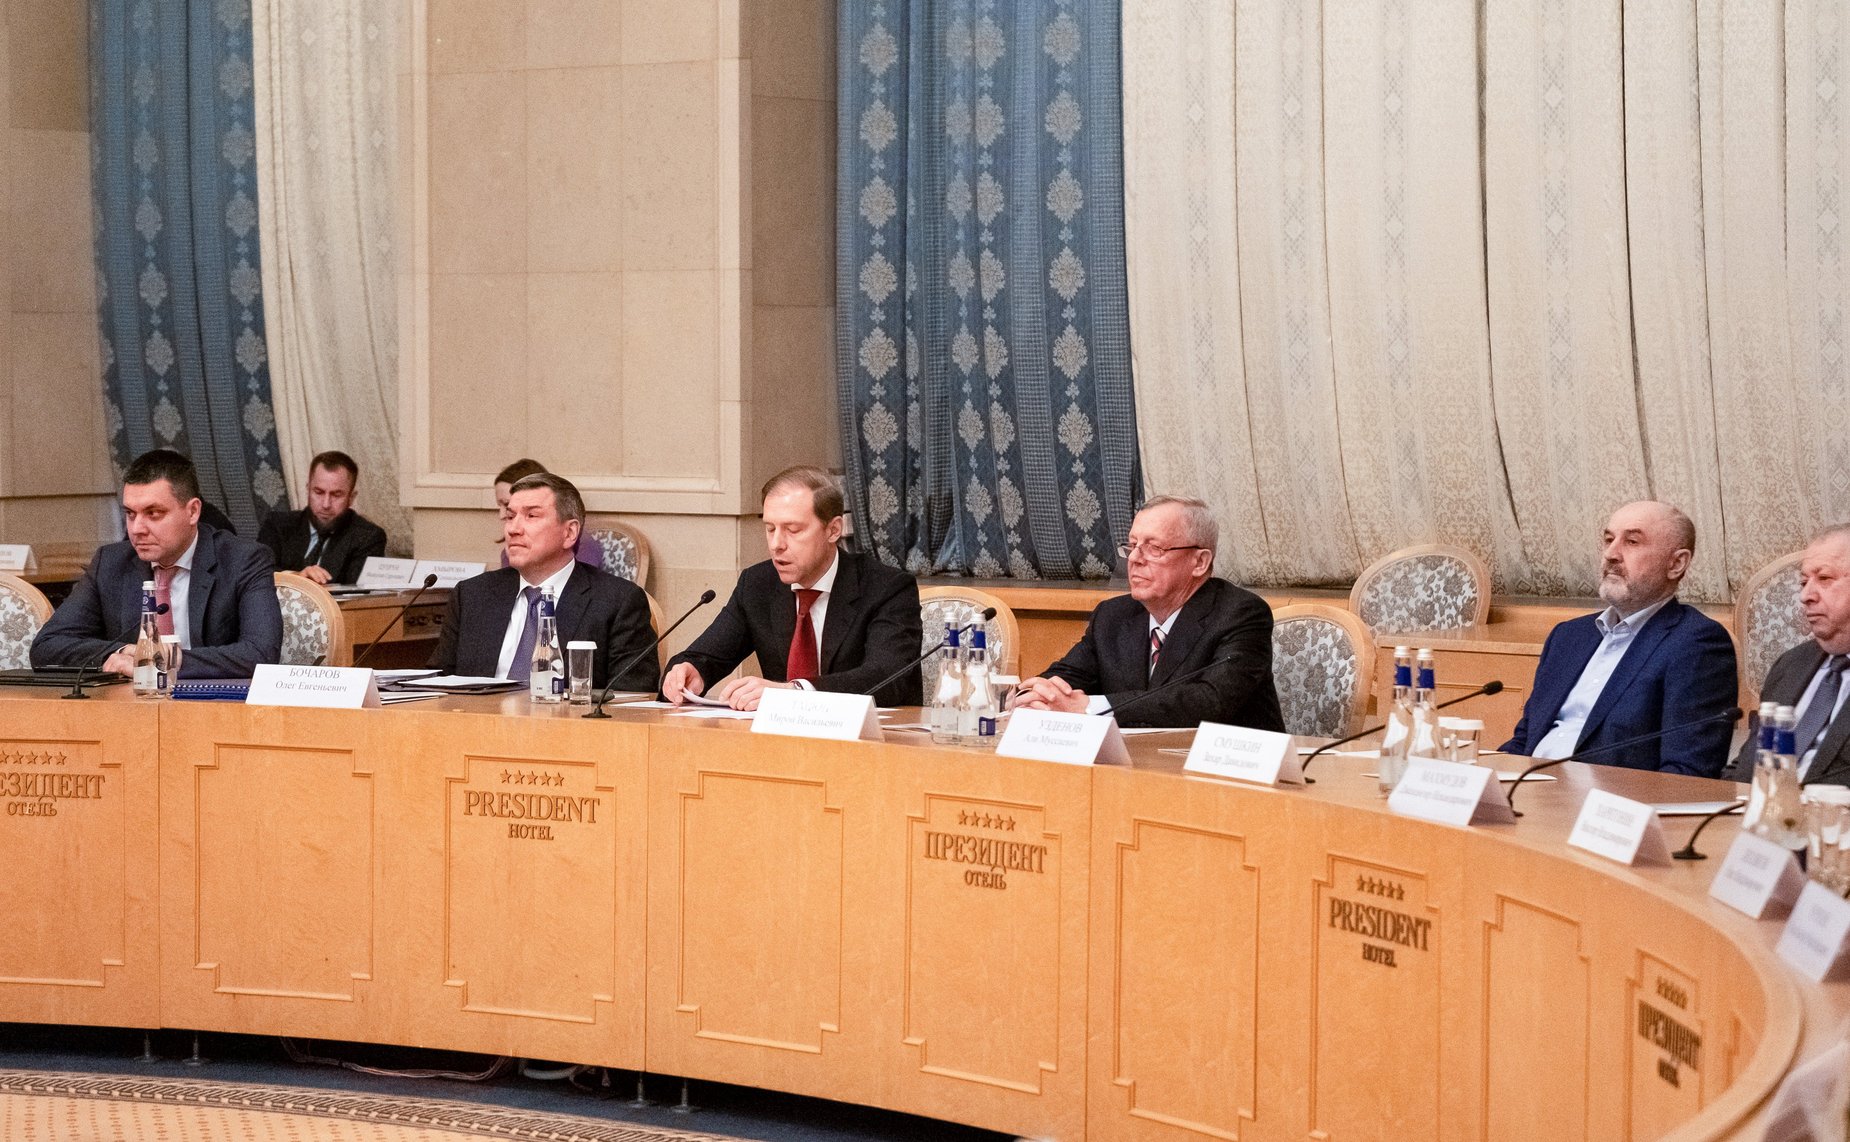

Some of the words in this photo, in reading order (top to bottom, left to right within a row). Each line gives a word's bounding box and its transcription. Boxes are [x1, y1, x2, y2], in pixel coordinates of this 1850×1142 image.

[288, 667, 341, 679] БОЧАРОВ
[275, 680, 296, 690] Олег
[298, 681, 347, 693] Евгеньевич
[7, 801, 58, 816] ОТЕЛЬ
[463, 790, 600, 823] PRESIDENT
[508, 823, 554, 840] HOTEL
[924, 830, 1047, 874] ПРЕЗИДЕНТ
[964, 869, 1007, 890] ОТЕЛЬ
[1329, 896, 1432, 952] PRESIDENT
[1362, 942, 1398, 968] HOTEL
